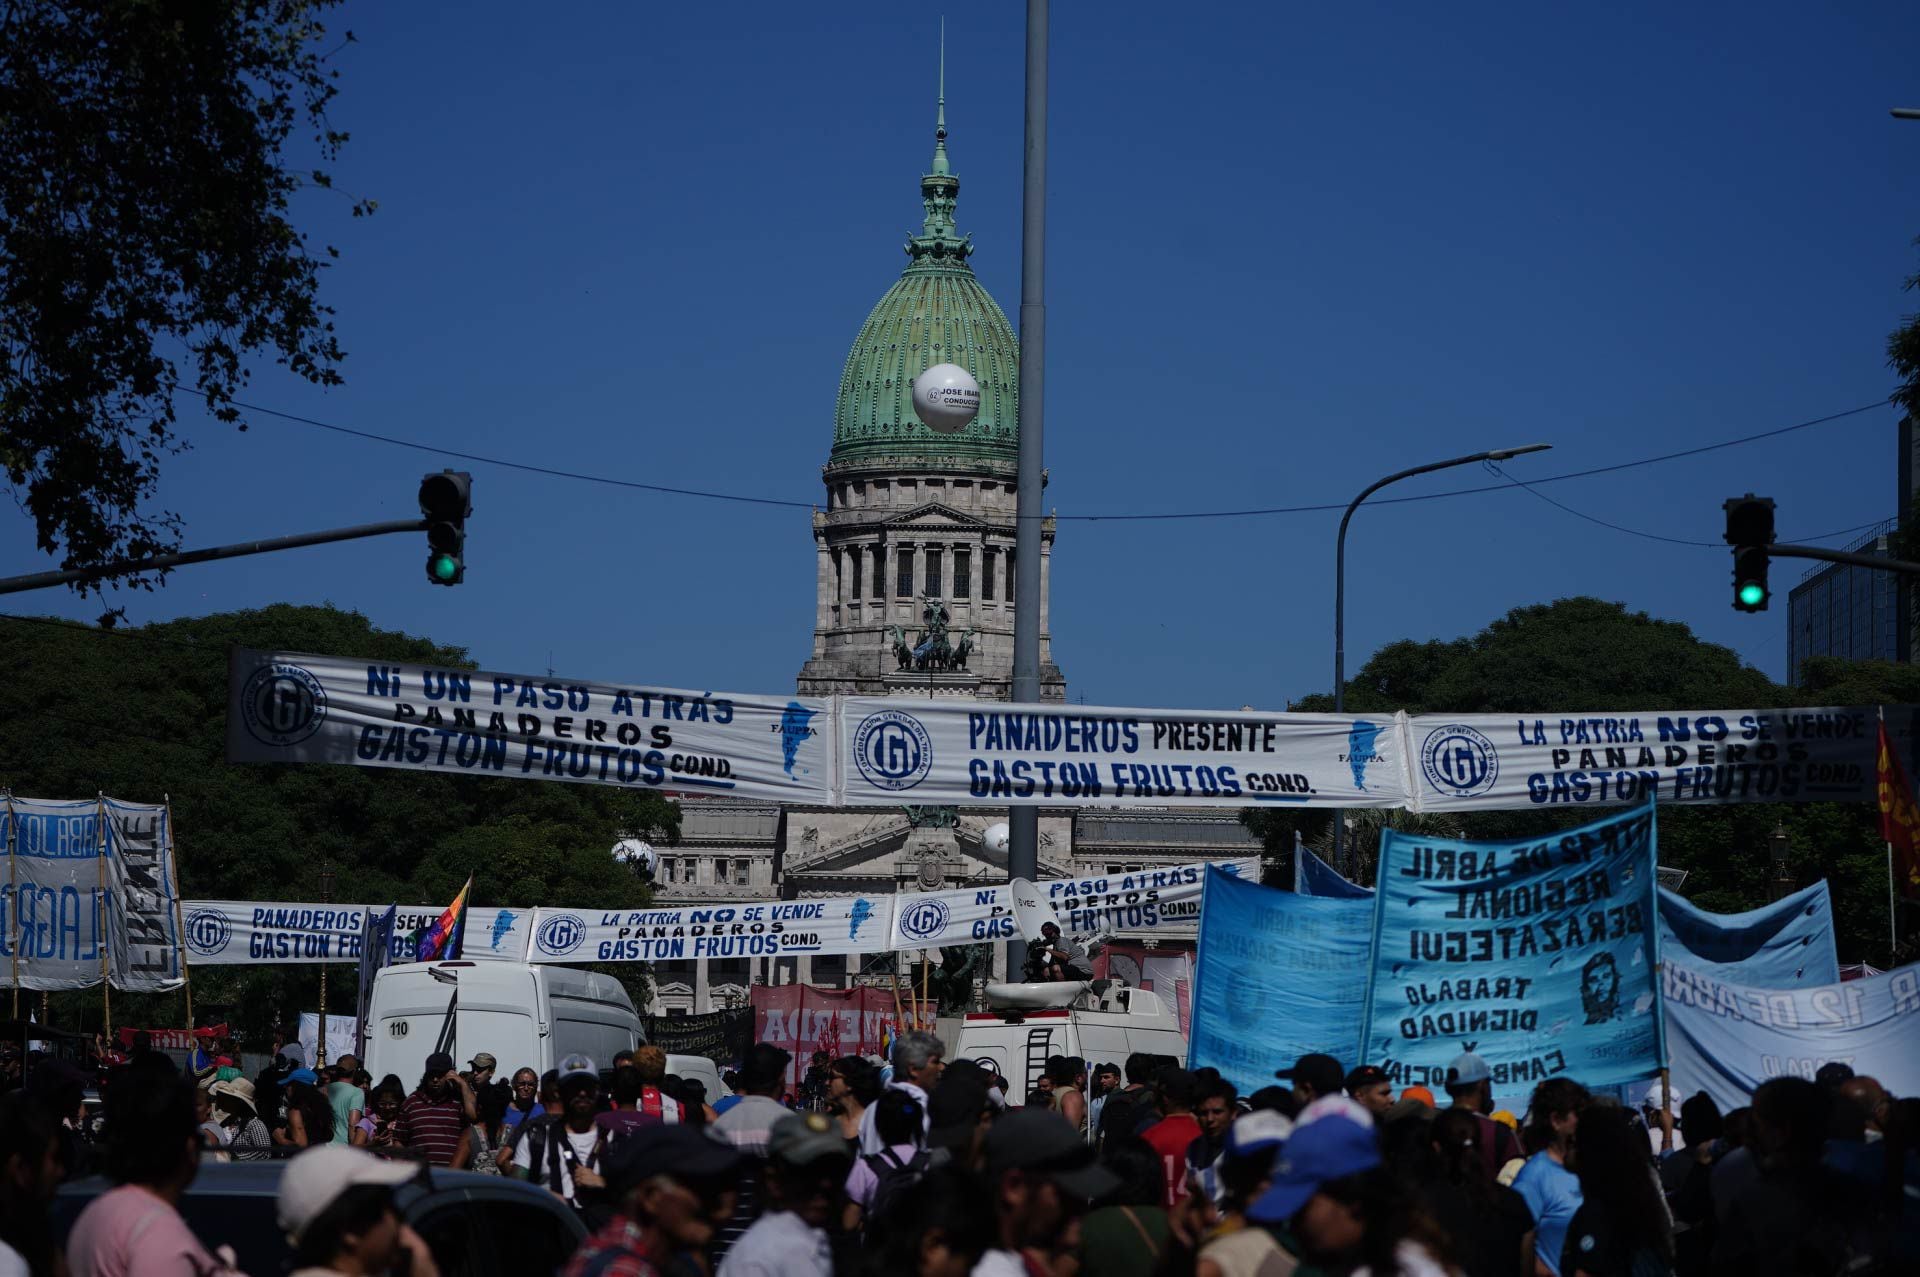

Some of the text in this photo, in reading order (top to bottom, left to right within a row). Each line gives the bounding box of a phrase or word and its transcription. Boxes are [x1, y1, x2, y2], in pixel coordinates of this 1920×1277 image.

[941, 388, 963, 396] JOSE
[423, 671, 470, 702] UN
[494, 677, 589, 712] PASO
[612, 690, 734, 724] ATRÁS
[394, 703, 674, 748] PANADEROS
[882, 714, 915, 729] GENERAL
[914, 727, 925, 741] DEL
[968, 712, 1276, 753] PANADEROS PRESENTE
[1447, 728, 1480, 740] GENERAL
[1519, 720, 1547, 745] LA
[1657, 716, 1729, 742] NO
[1740, 715, 1772, 740] SE
[1782, 714, 1864, 739] VENDE
[357, 724, 738, 786] GASTON FRUTOS COND.
[1552, 743, 1808, 769] PANADEROS
[968, 759, 1317, 798] GASTON FRUTOS COND.
[1528, 769, 1660, 803] GASTON
[1674, 764, 1799, 799] FRUTOS
[1050, 879, 1108, 899] PASO
[1122, 866, 1198, 891] ATRÁS
[253, 908, 440, 930] PANADEROS SENT
[601, 913, 620, 926] LA
[690, 909, 736, 924] NO
[743, 906, 764, 921] SE
[771, 903, 825, 920] VENDE
[619, 922, 784, 939] PANADEROS
[249, 932, 331, 958] GASTON
[338, 934, 416, 959] FROS
[598, 933, 822, 960] GASTON FRUTOS COND.
[390, 1022, 408, 1036] 110
